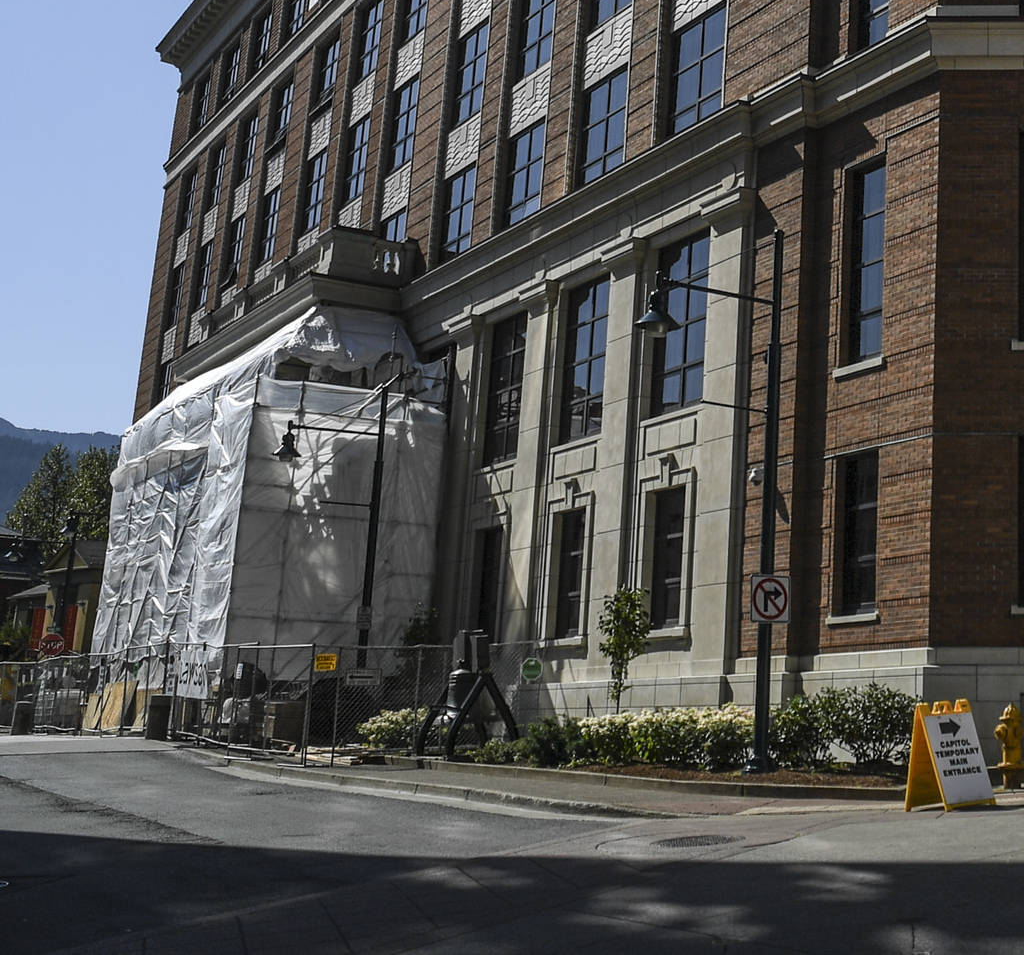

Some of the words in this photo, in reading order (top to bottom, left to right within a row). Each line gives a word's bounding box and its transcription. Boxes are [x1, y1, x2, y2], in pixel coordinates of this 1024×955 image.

[40, 640, 62, 649] STOP
[940, 739, 970, 748] CAPITOL
[935, 747, 979, 758] TEMPORARY
[949, 758, 968, 766] MAIN
[943, 766, 982, 777] ENTRANCE
